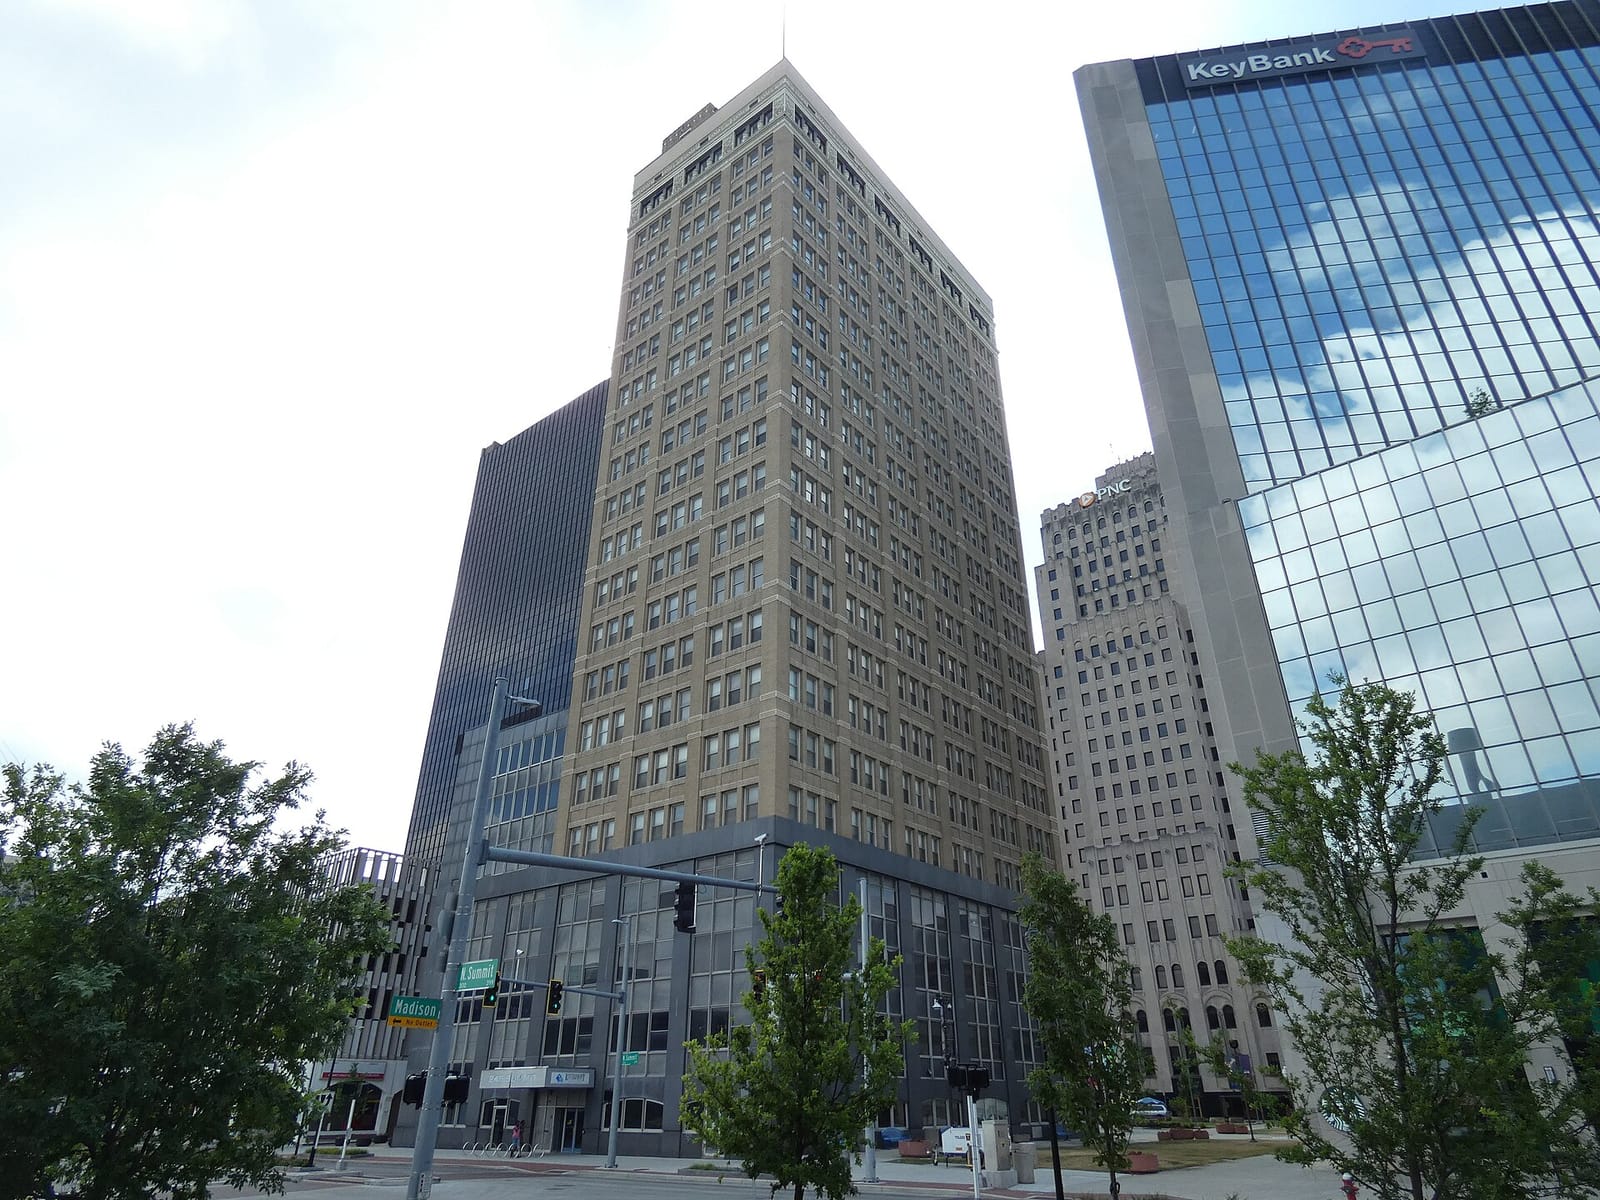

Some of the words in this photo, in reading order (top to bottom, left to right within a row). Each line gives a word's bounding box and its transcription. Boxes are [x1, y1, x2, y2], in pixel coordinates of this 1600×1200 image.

[1187, 47, 1336, 80] KeyBank
[1097, 479, 1132, 500] PNC
[467, 964, 494, 980] Summit
[394, 999, 437, 1017] Madison
